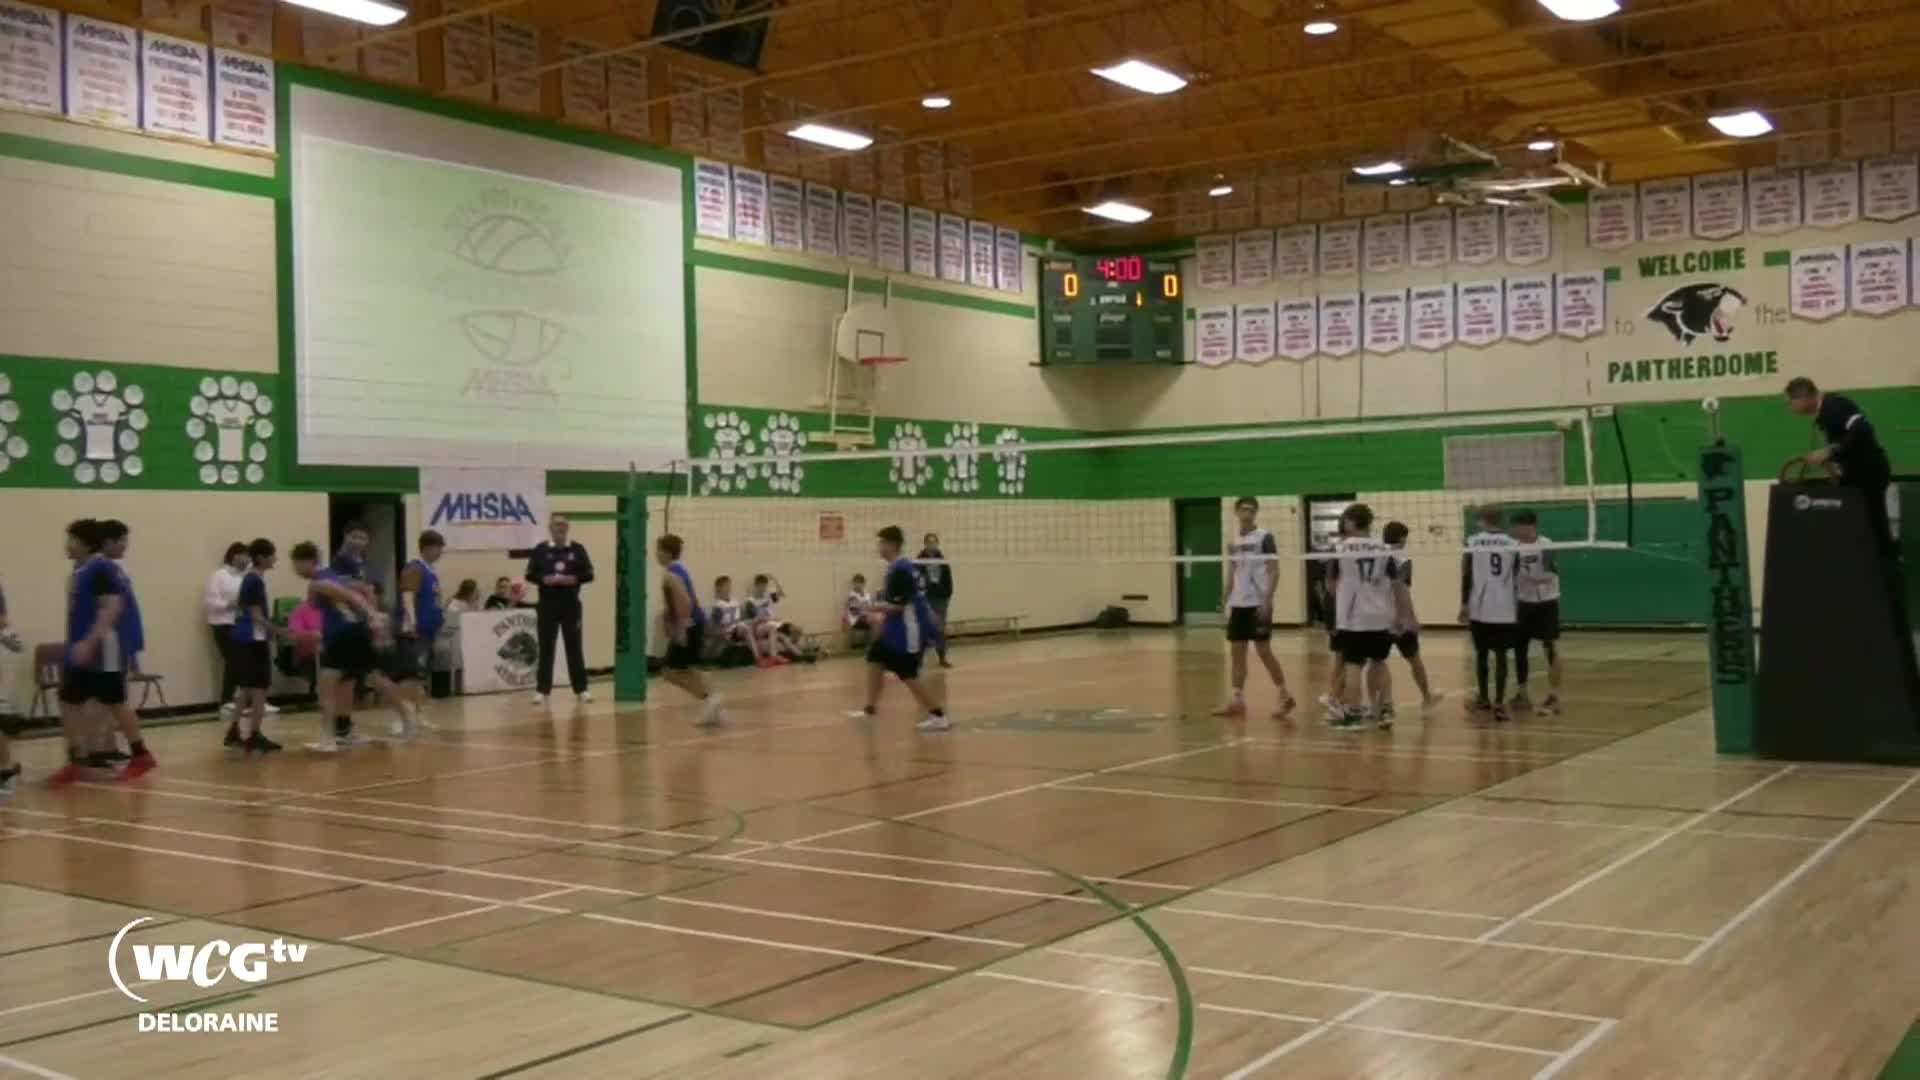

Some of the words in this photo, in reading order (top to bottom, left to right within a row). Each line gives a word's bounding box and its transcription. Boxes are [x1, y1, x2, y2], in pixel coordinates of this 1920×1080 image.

[1096, 256, 1142, 280] 4:00
[1638, 247, 1746, 277] WELCOME
[1064, 273, 1078, 296] 0
[1164, 274, 1178, 296] 0
[1614, 317, 1635, 336] to
[1755, 304, 1787, 325] the
[1608, 351, 1779, 384] PANTHERDOME
[430, 492, 537, 526] MHSAA
[1489, 552, 1503, 577] 9
